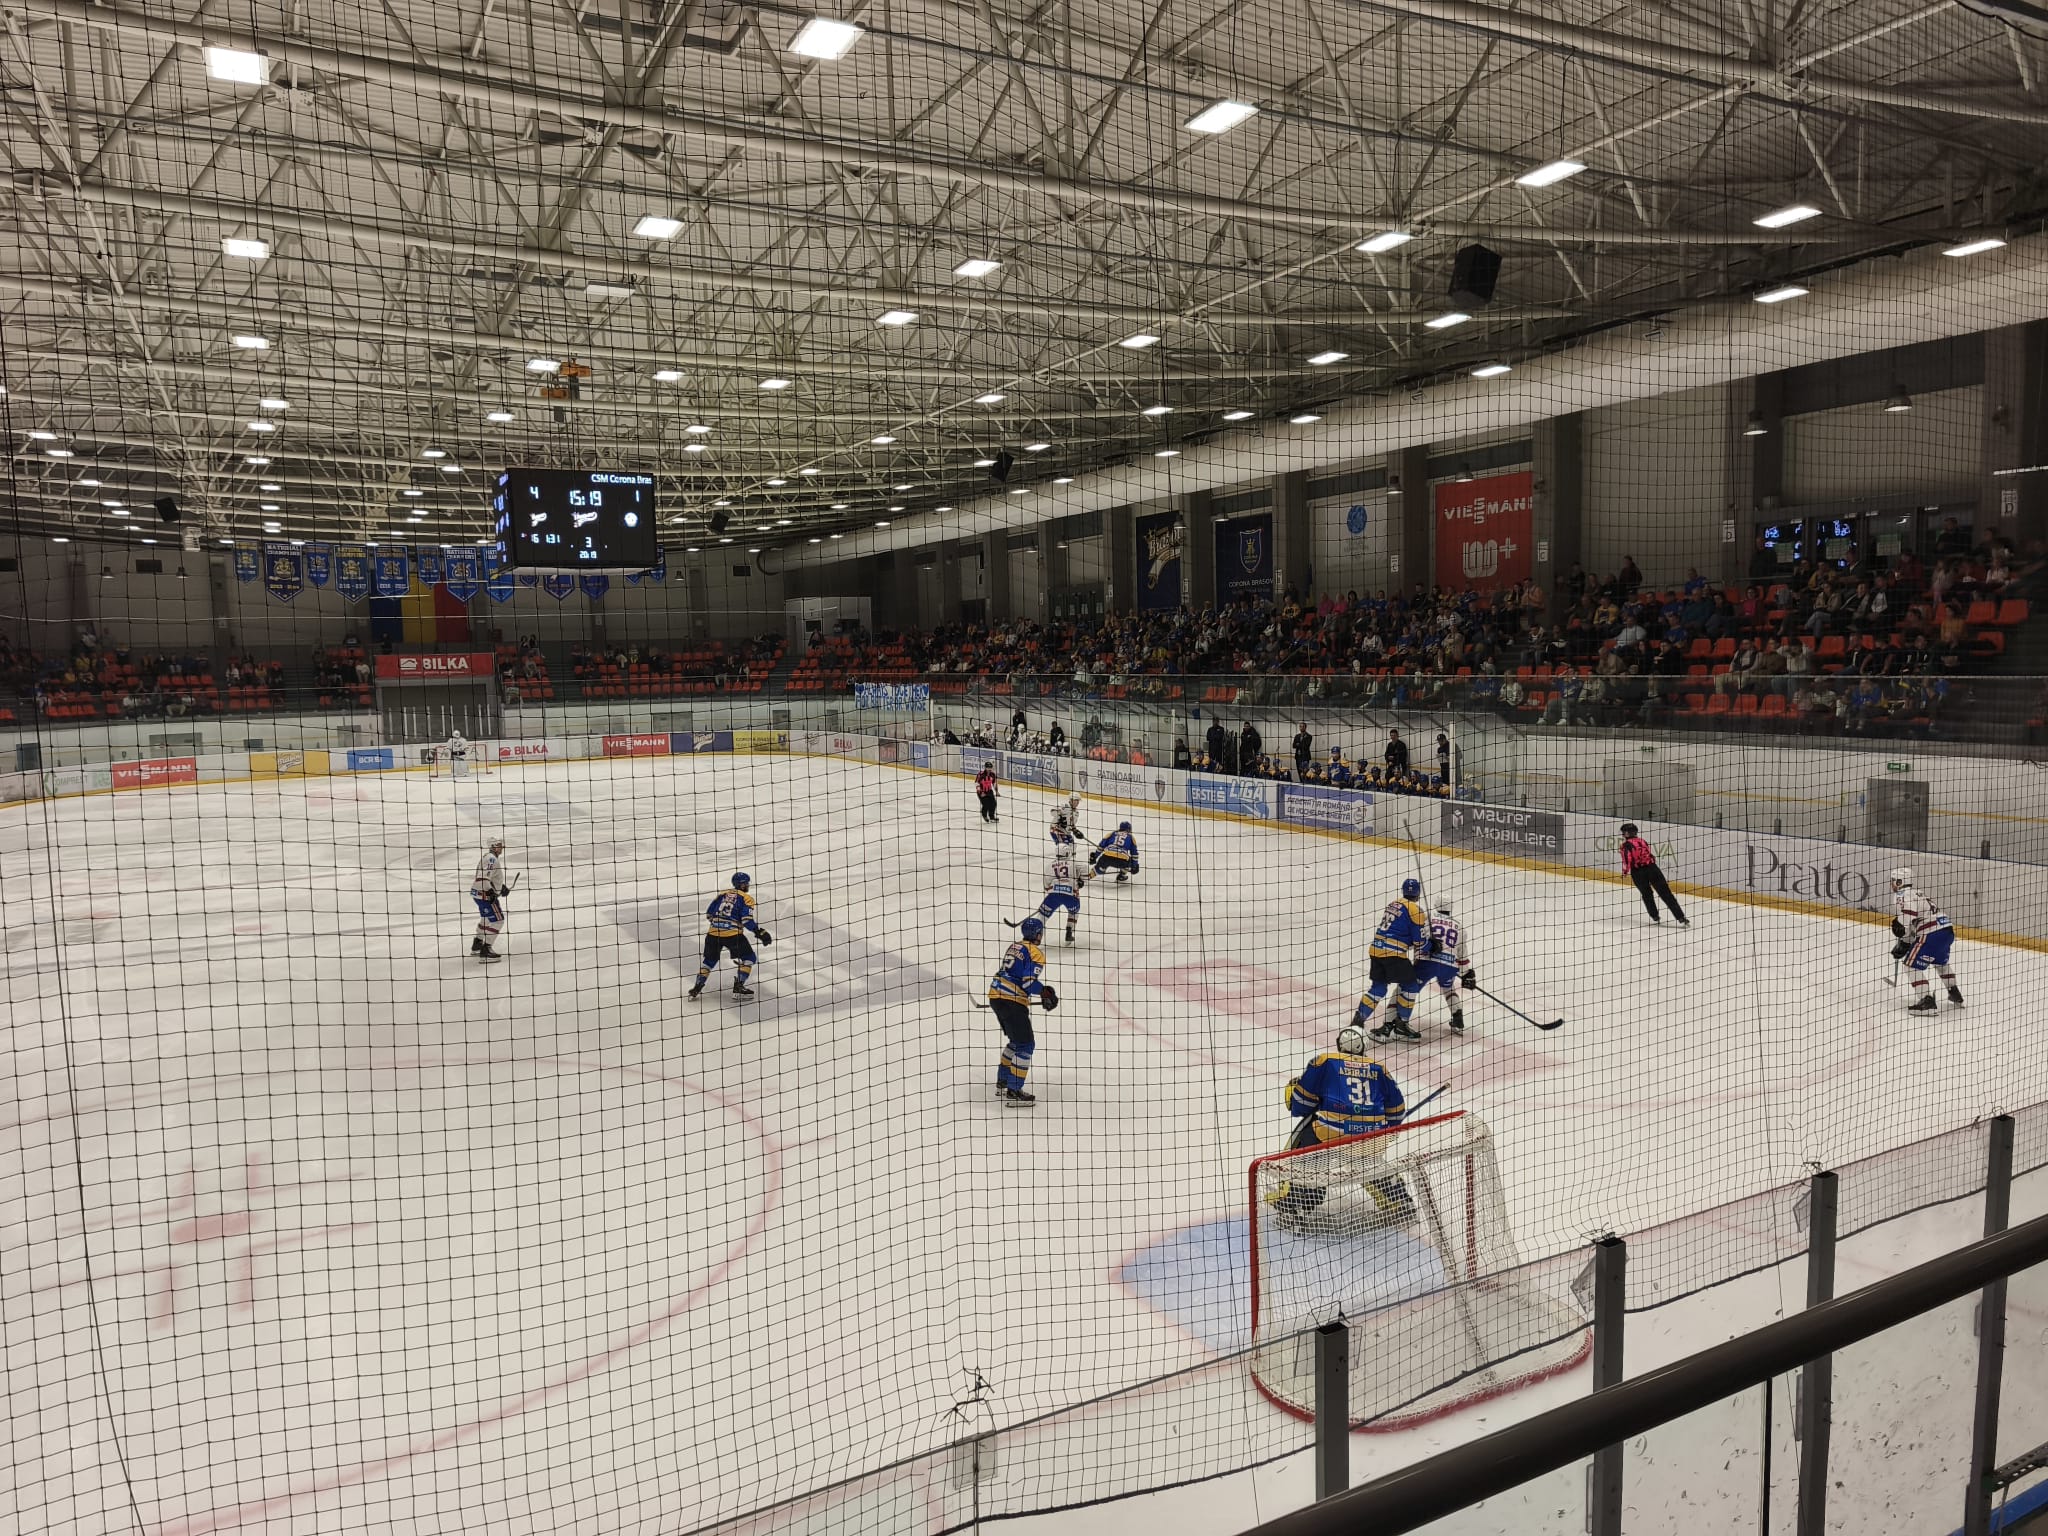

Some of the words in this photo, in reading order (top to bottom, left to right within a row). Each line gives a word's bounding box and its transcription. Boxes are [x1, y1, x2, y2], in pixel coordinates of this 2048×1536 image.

[591, 474, 608, 482] CSM
[610, 474, 636, 484] Corona
[530, 486, 539, 499] 4
[569, 490, 602, 506] 15:19
[635, 490, 640, 502] 1
[585, 537, 592, 548] 3
[422, 657, 468, 670] BILKA
[514, 745, 549, 755] BILKA
[607, 738, 665, 751] VIESSMANN
[1192, 787, 1216, 802] ERSTE
[1229, 779, 1265, 801] LIGA
[1746, 845, 1870, 902] Prato
[1431, 926, 1458, 948] 28
[1346, 1077, 1375, 1106] 31
